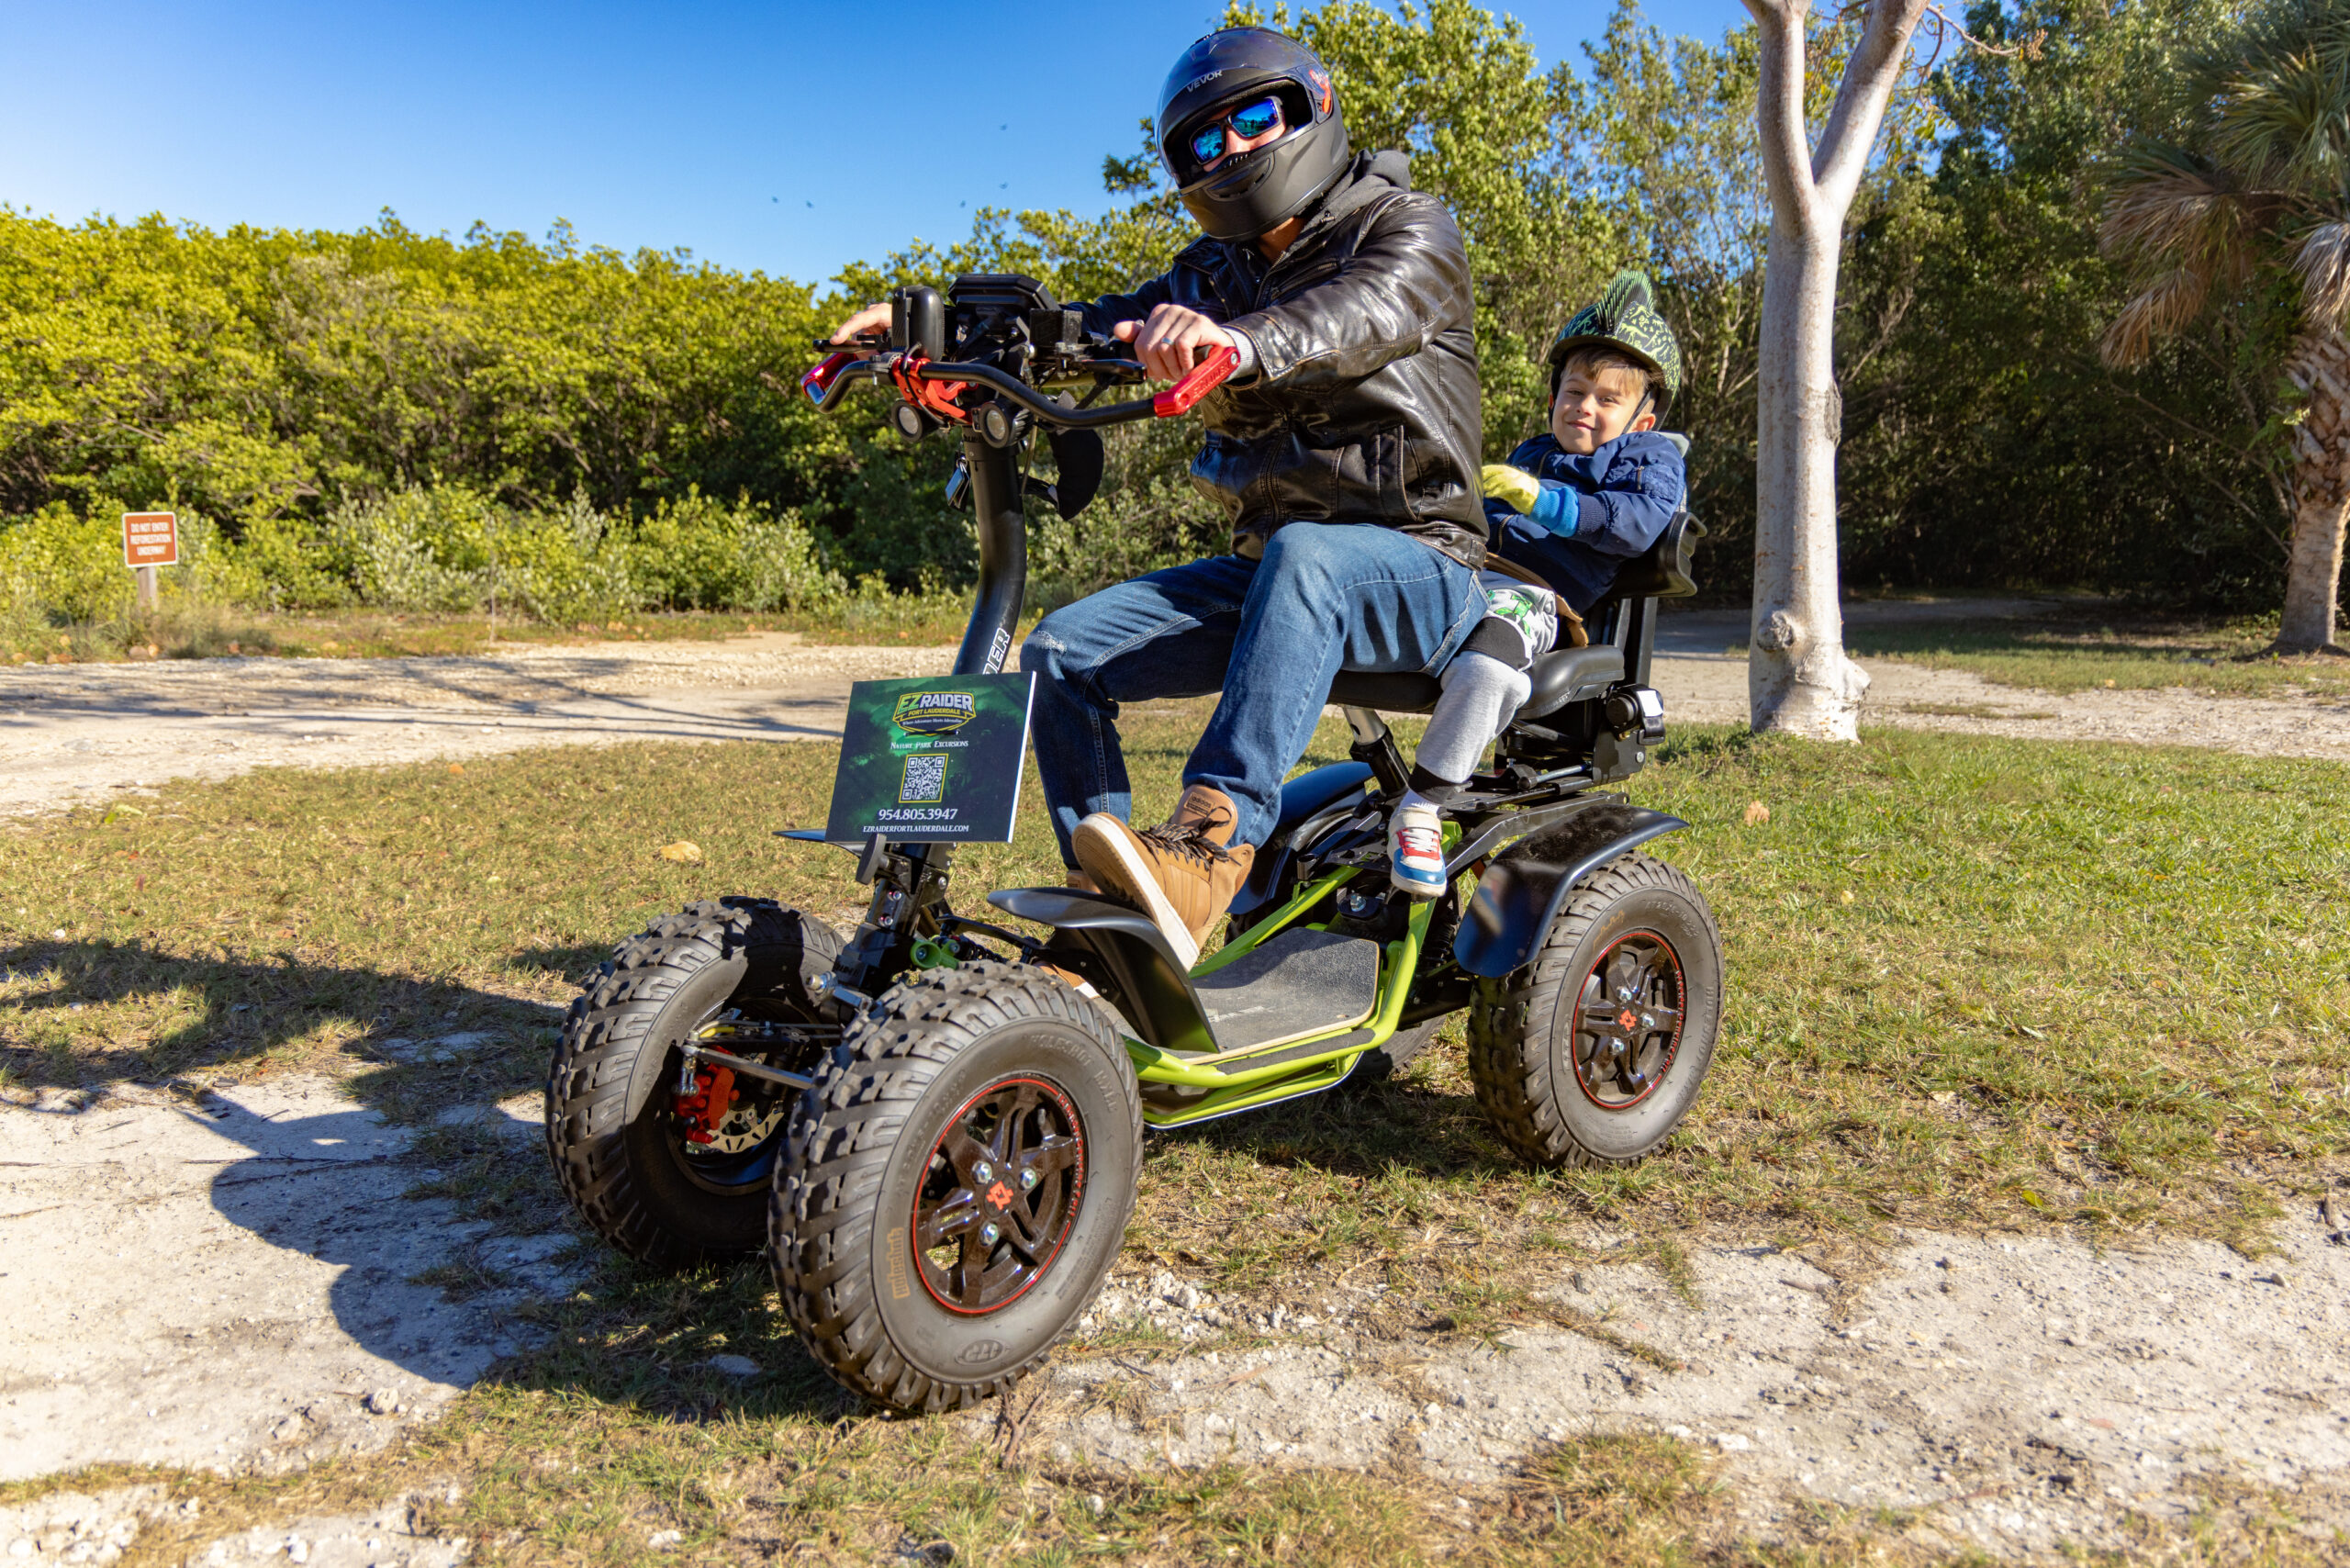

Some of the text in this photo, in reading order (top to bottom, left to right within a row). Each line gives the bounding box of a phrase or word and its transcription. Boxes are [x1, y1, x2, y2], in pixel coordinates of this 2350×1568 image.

[1187, 69, 1223, 93] VEVOR
[908, 709, 923, 717] FORT
[878, 808, 957, 821] 954.805.3947
[863, 824, 969, 833] EZRAIDERFORTLAUDERDALE.COM
